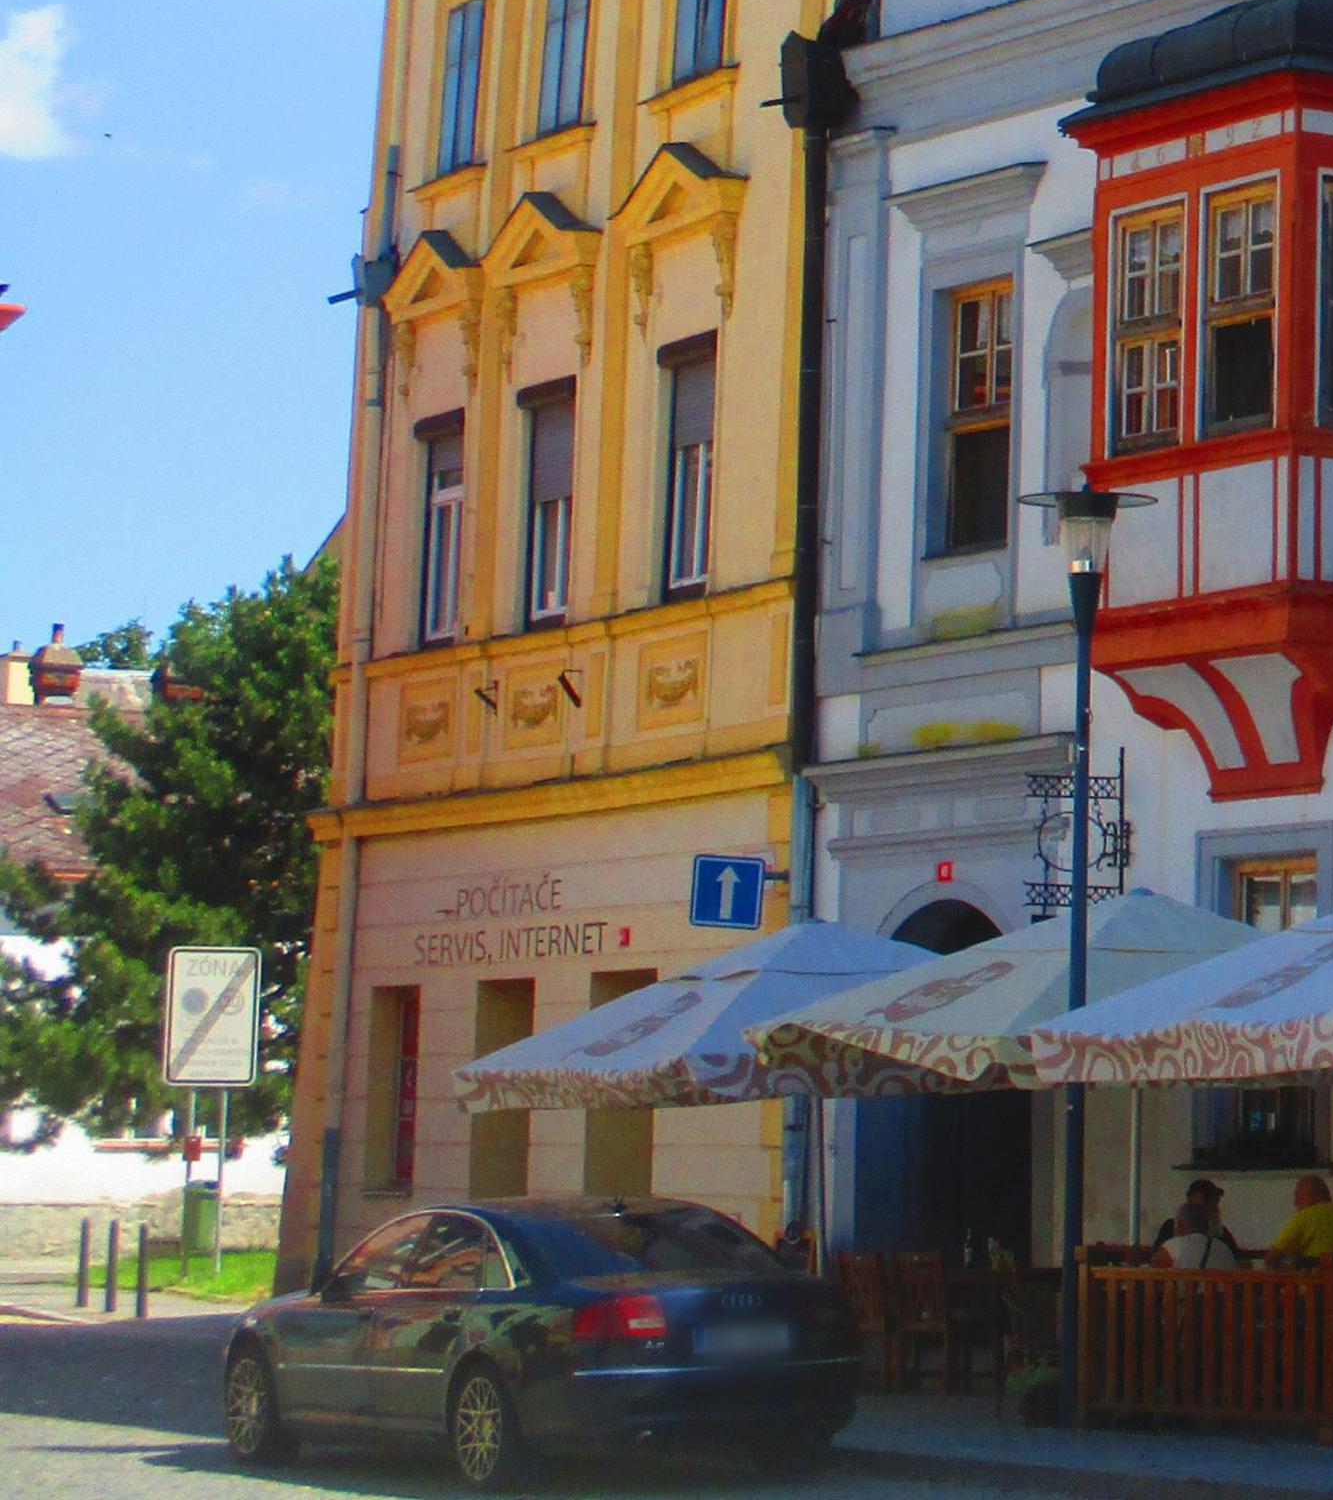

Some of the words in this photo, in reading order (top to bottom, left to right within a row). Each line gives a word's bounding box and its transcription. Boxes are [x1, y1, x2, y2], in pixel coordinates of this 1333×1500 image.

[455, 873, 563, 919] POČÍTAČE
[414, 930, 493, 966] SERVIS,
[498, 921, 608, 960] INTERNET
